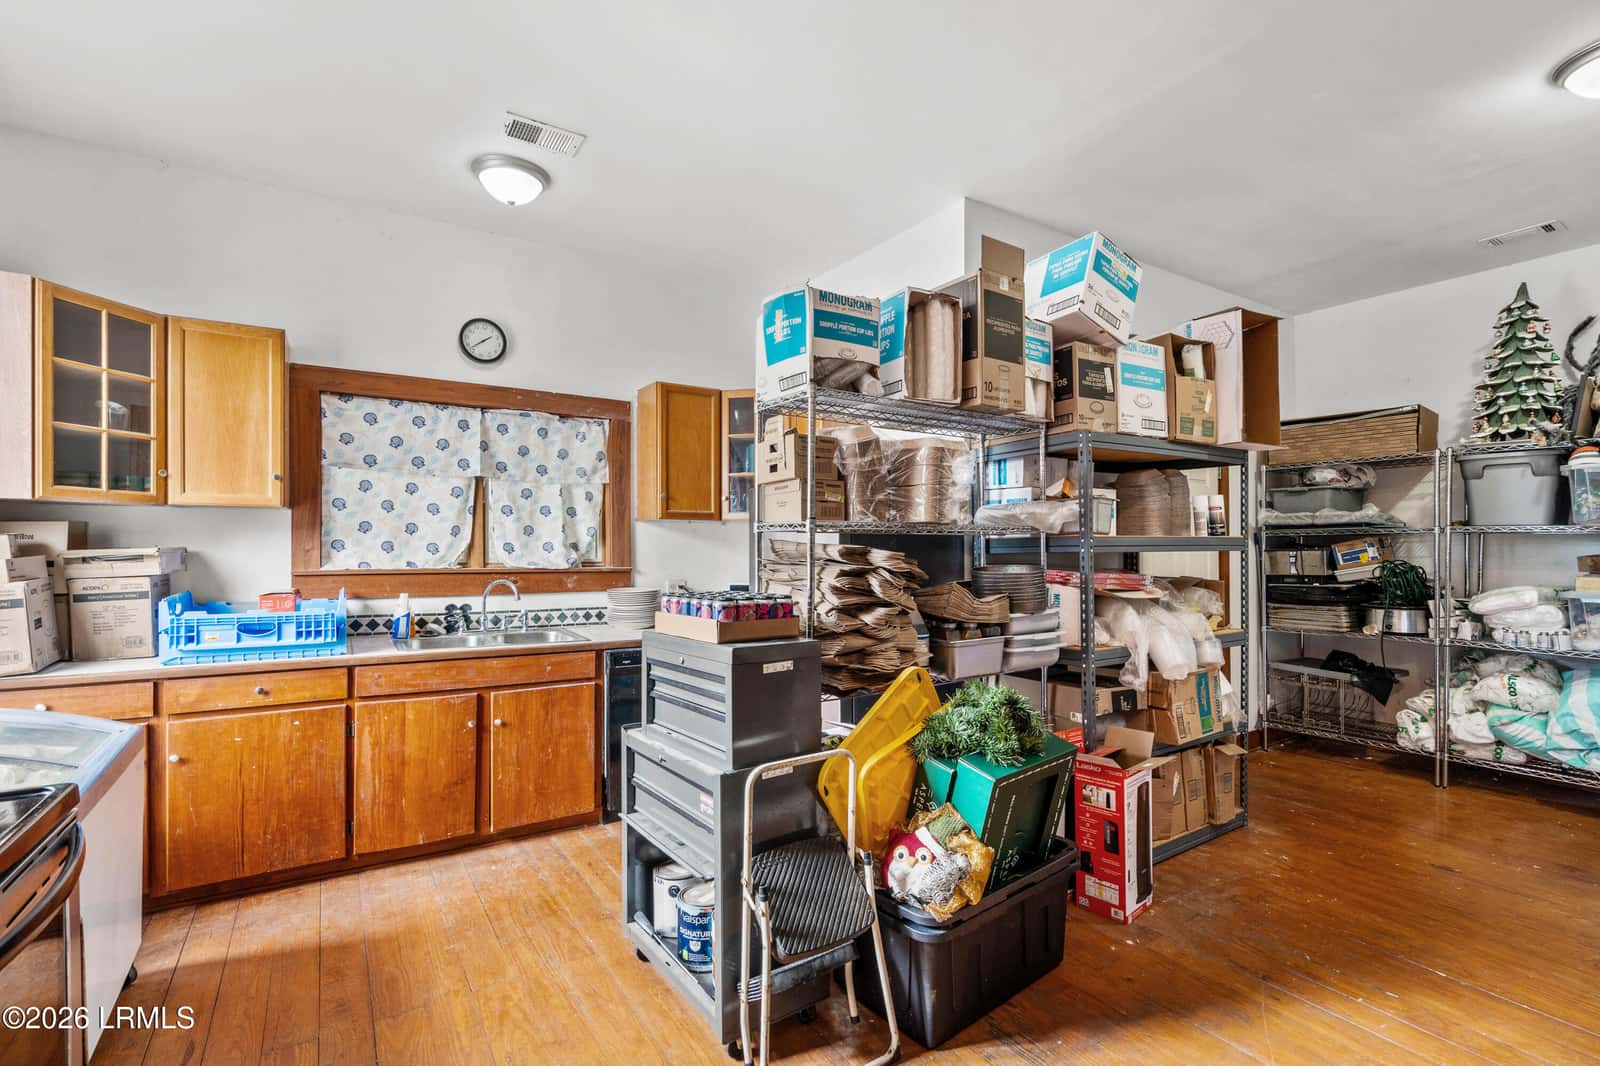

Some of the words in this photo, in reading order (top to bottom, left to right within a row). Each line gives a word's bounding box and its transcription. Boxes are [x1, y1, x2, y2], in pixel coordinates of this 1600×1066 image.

[1102, 239, 1137, 273] MONOGRAM
[819, 290, 873, 312] MONOGRAM
[984, 381, 992, 393] 10
[1076, 761, 1101, 772] Lasko
